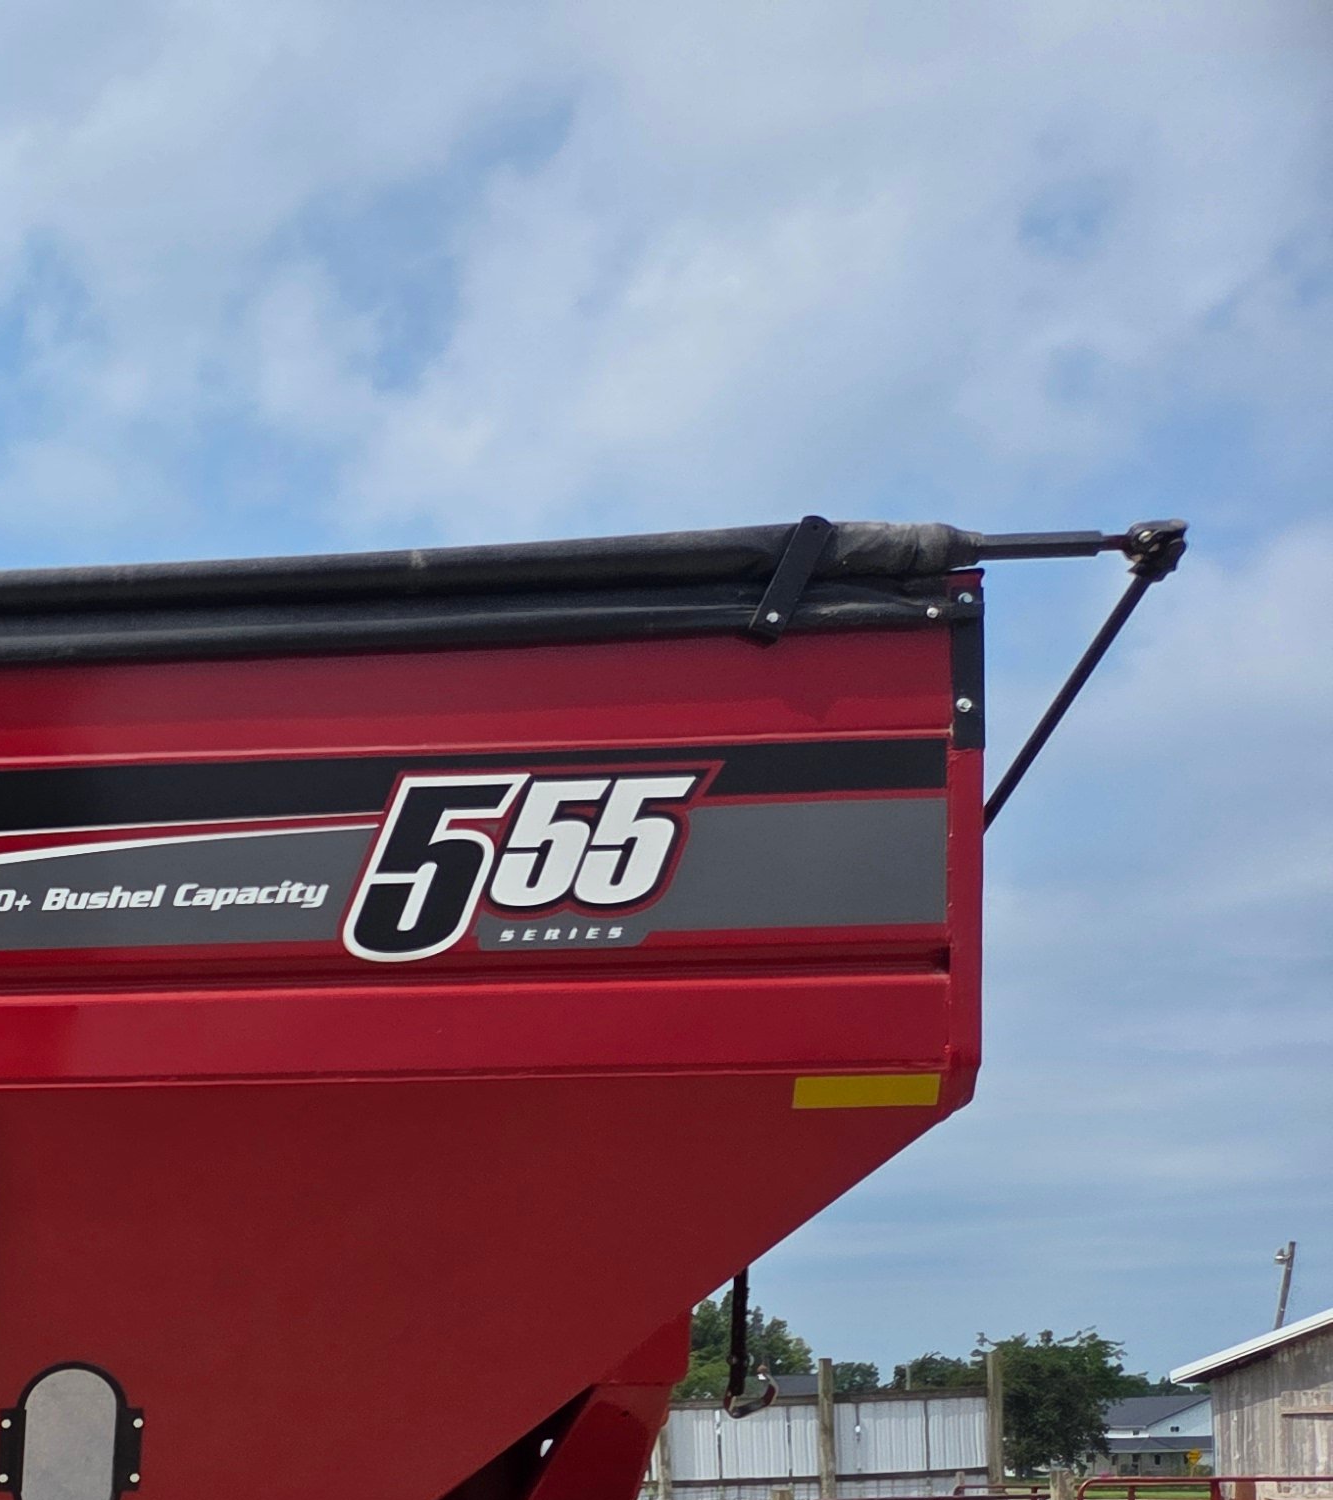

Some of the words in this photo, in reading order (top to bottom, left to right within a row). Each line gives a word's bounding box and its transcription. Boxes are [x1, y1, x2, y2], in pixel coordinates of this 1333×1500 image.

[342, 773, 696, 963] 555
[41, 884, 167, 911] Bushel
[172, 879, 330, 911] Capacity
[499, 927, 624, 943] SERIES
